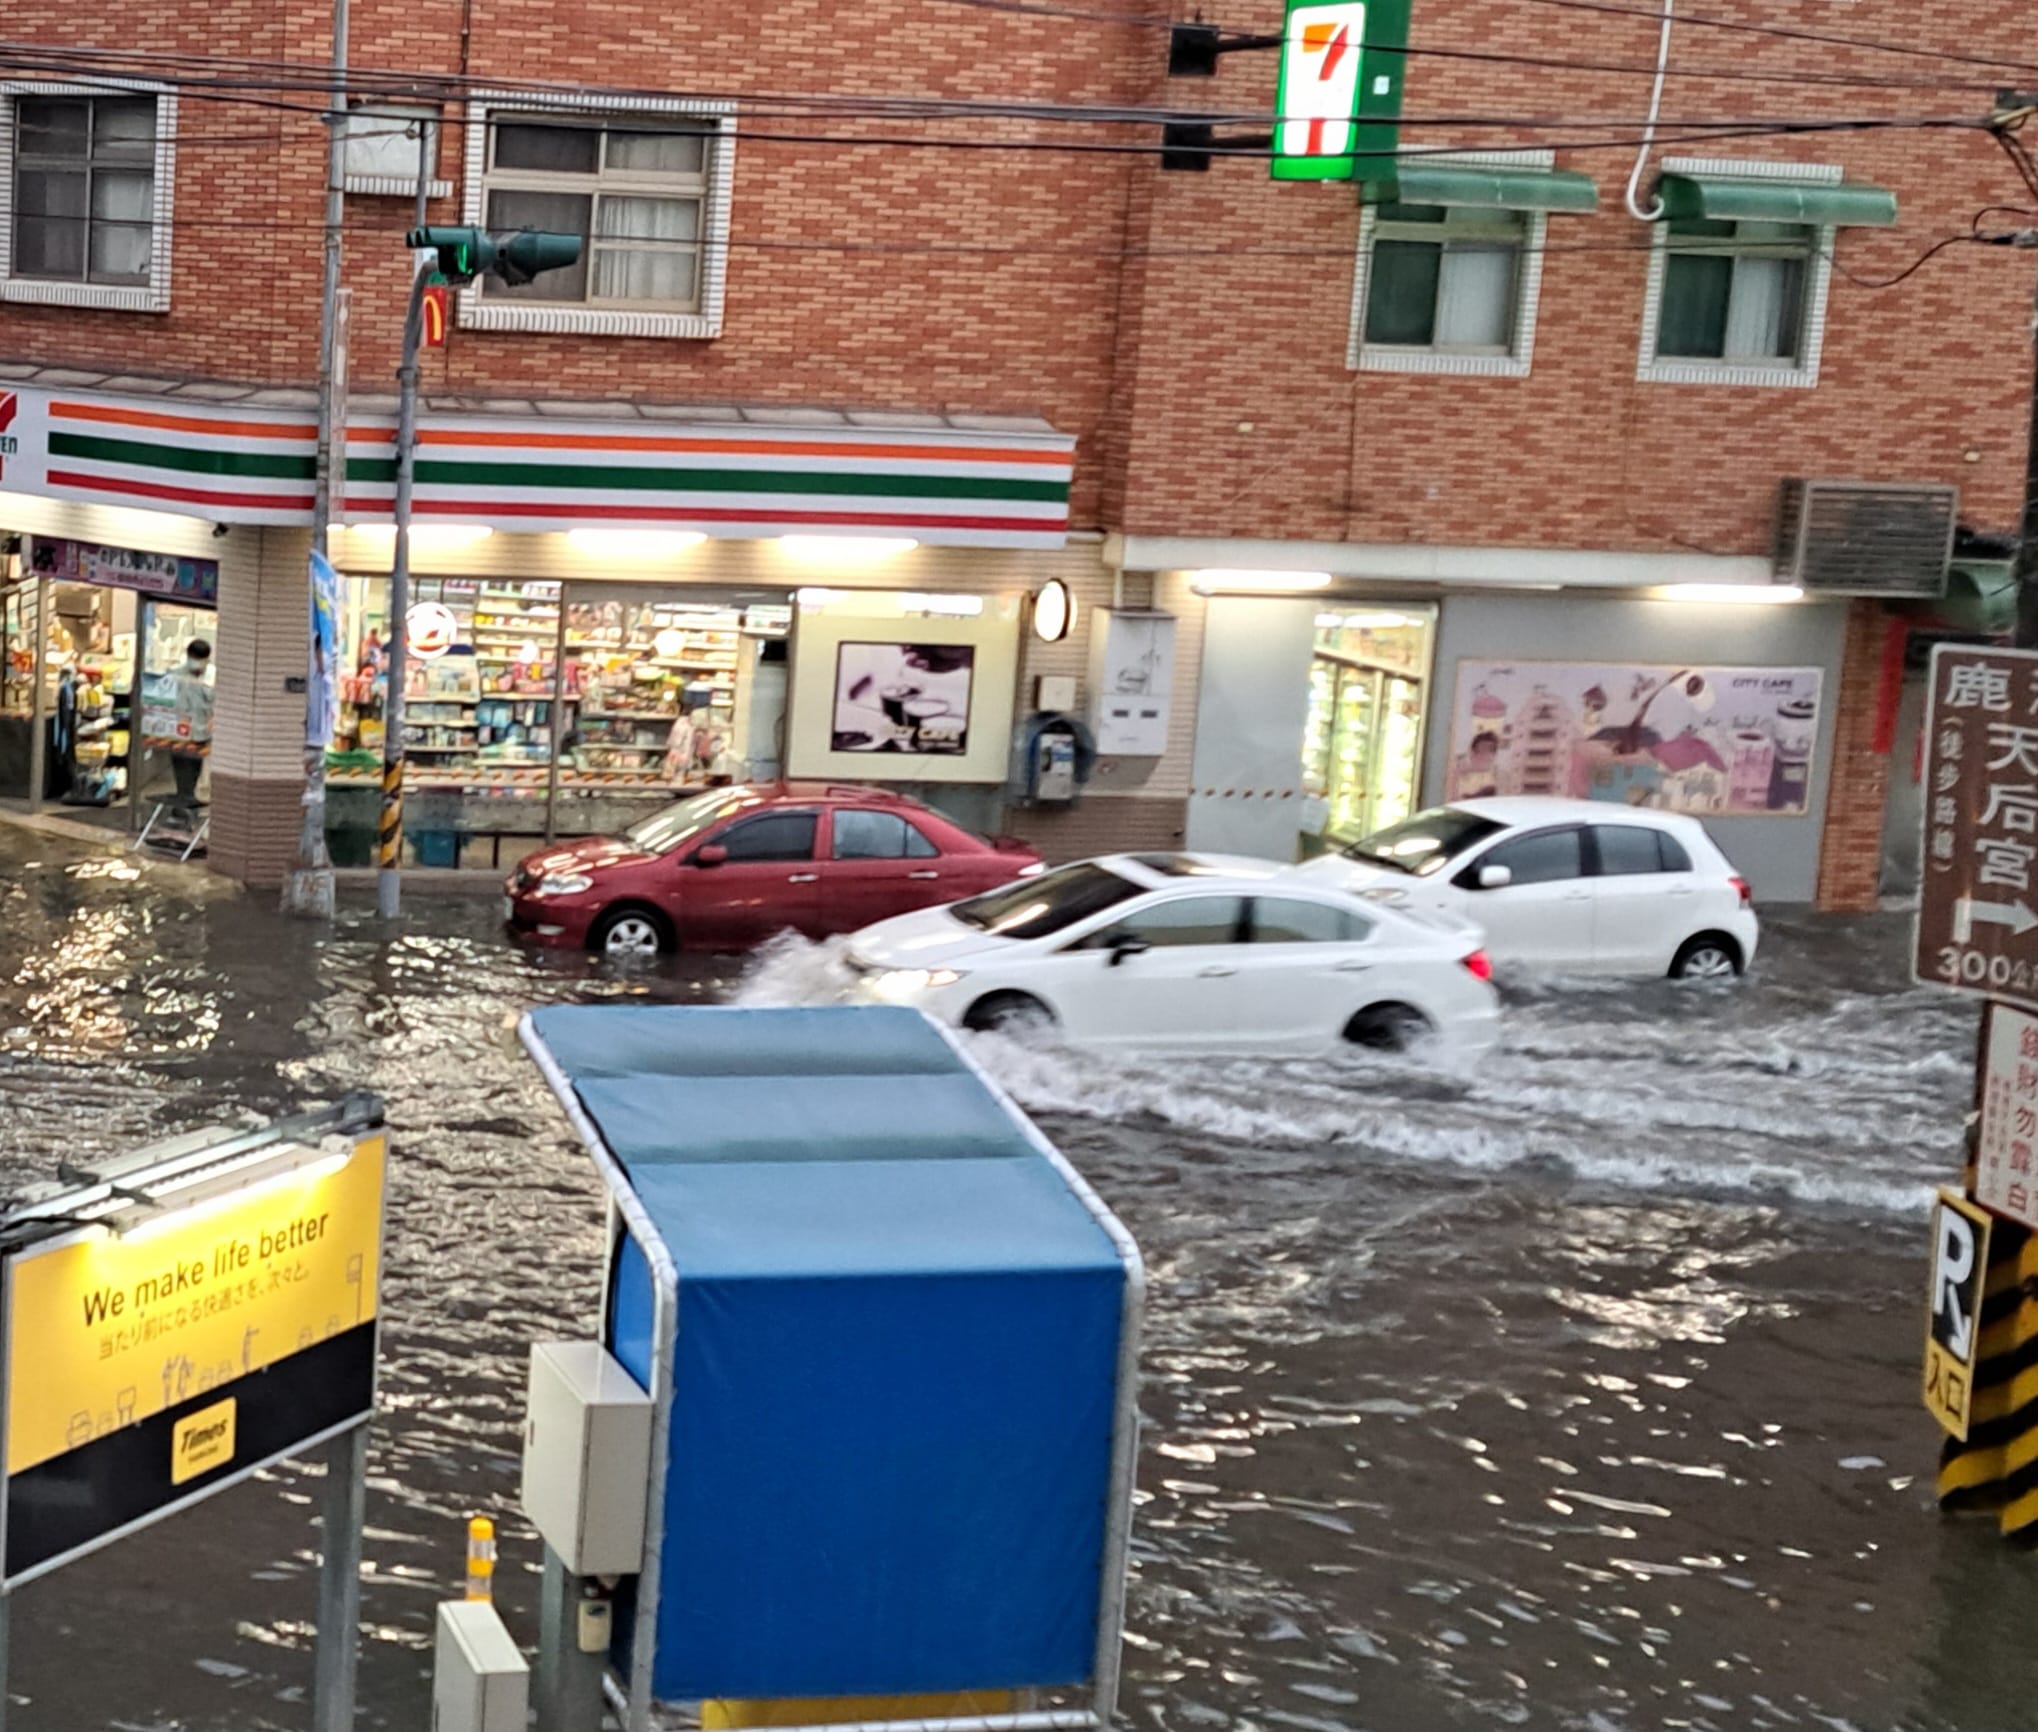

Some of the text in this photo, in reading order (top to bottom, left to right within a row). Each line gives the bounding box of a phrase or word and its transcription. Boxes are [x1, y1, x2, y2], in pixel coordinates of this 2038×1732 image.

[1944, 662, 2038, 713] 鹿
[1973, 722, 2038, 890] 天后宮
[83, 1214, 329, 1326] We make life better
[1928, 1352, 1966, 1424] 入口
[181, 1419, 228, 1454] Times
